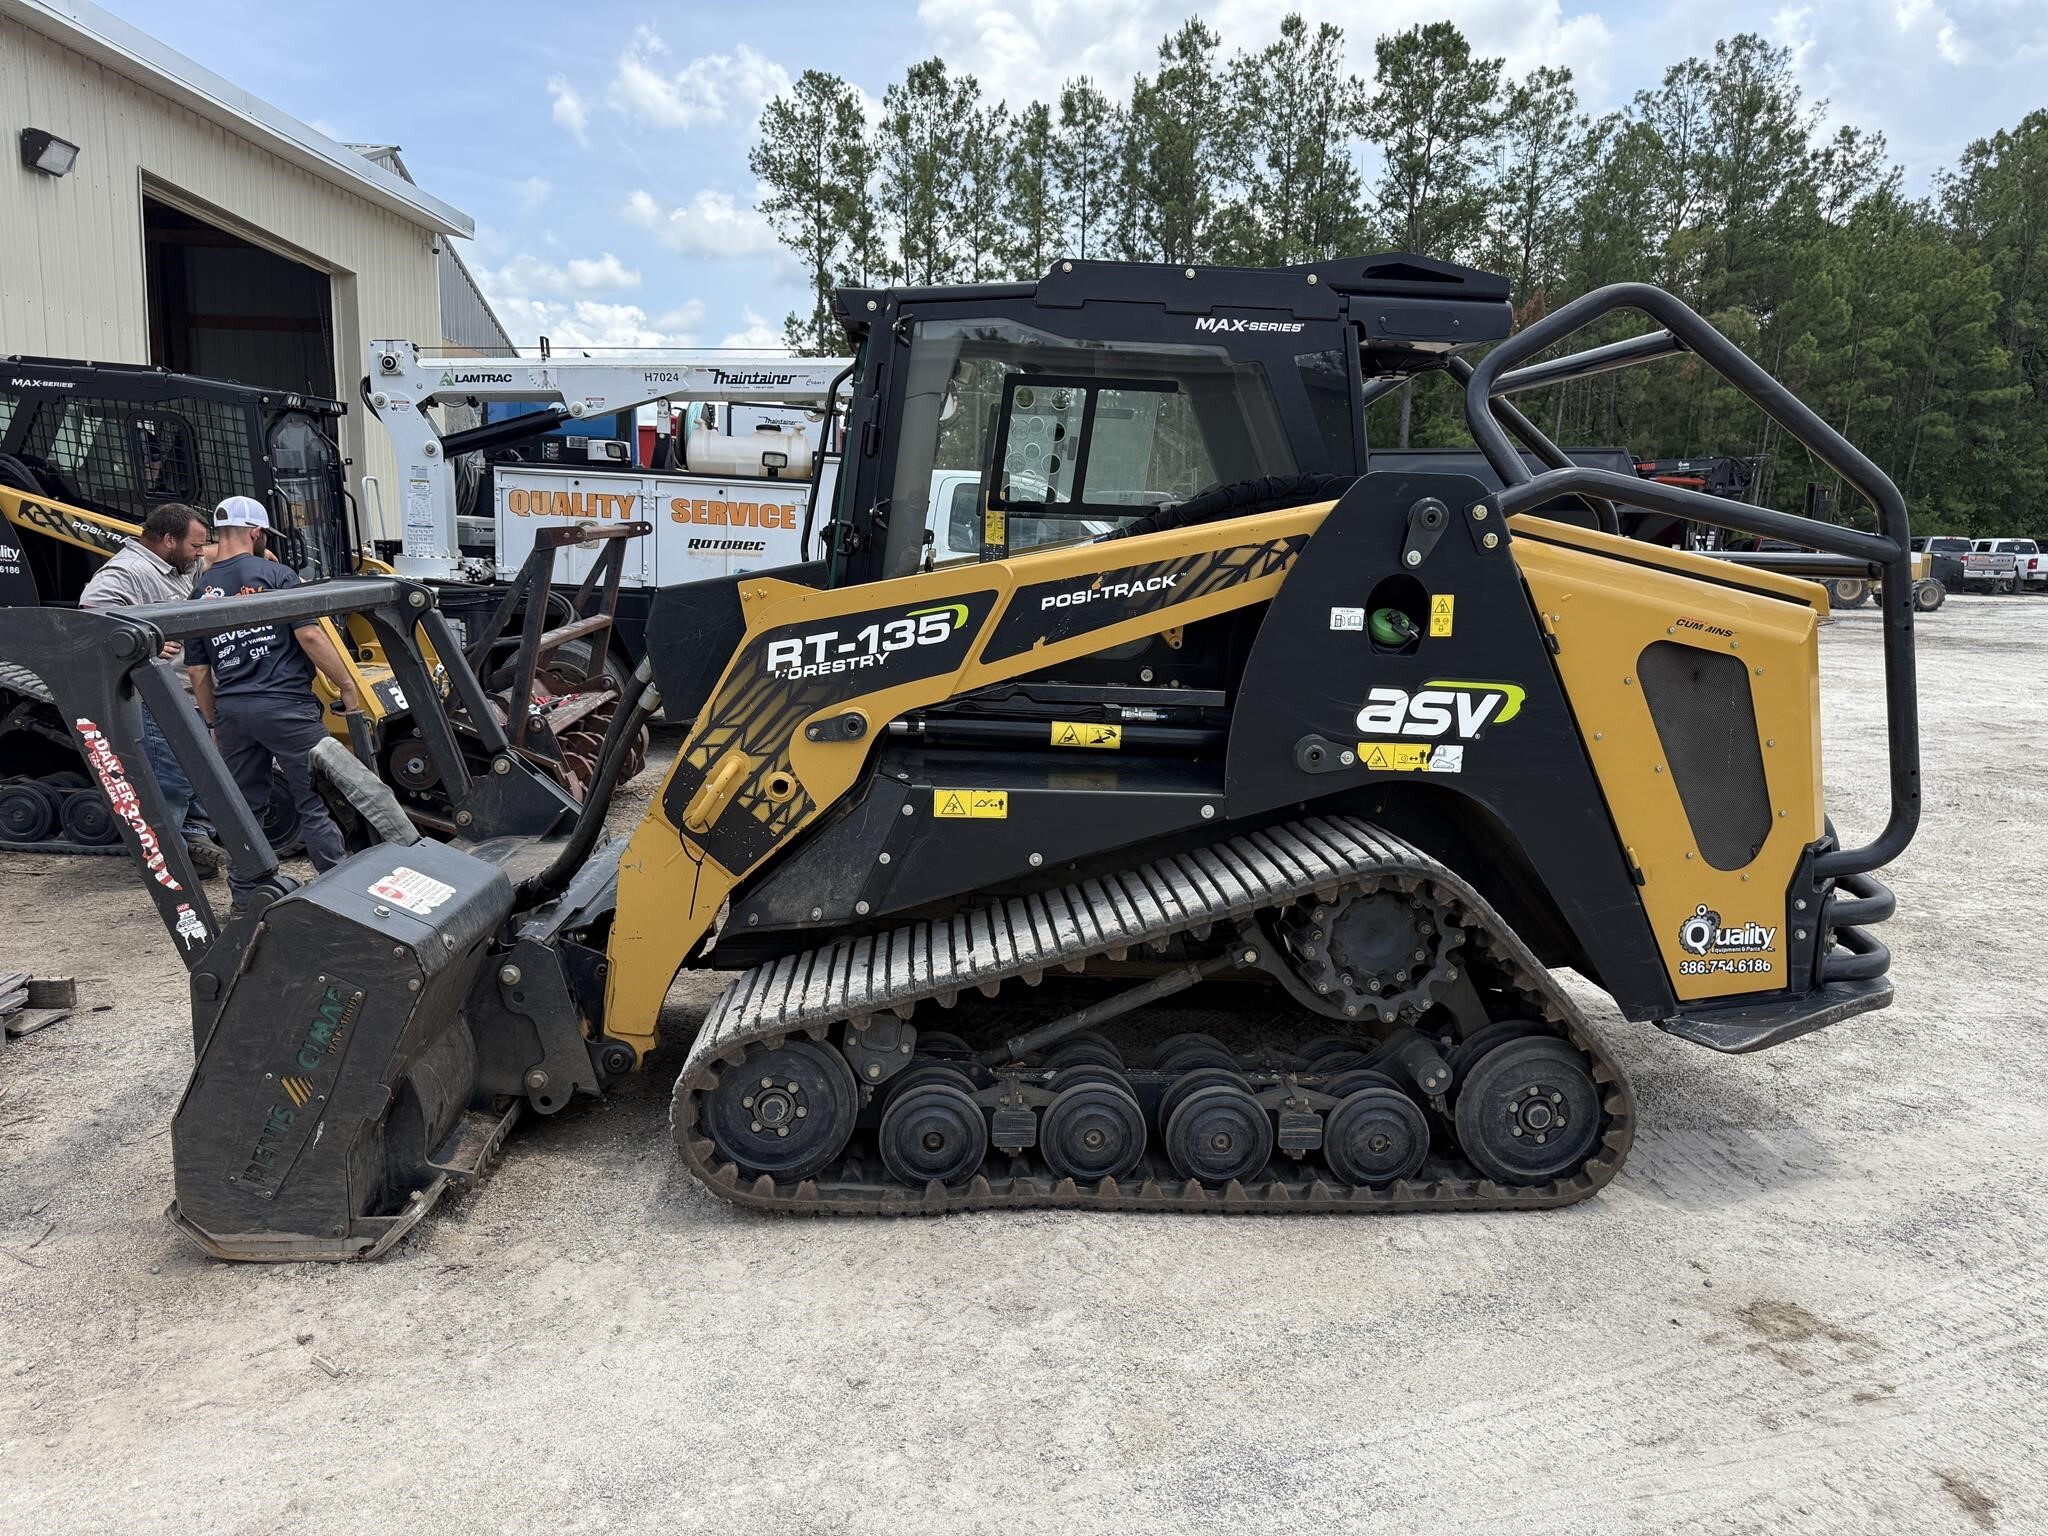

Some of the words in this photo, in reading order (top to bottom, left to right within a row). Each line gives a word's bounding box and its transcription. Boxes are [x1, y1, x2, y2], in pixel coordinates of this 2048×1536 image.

[1195, 317, 1305, 333] MAX-SERIES
[11, 378, 75, 388] MAX-SERIES
[454, 373, 513, 384] LAMTRAC
[645, 372, 680, 383] H7024
[707, 368, 798, 385] Maintainer
[508, 488, 636, 520] QUALITY
[671, 497, 797, 530] SERVICE
[71, 521, 128, 544] POSI-TRA
[1041, 573, 1177, 611] POSI-TRACK
[766, 611, 951, 672] RT-135
[1356, 687, 1502, 738] asv
[101, 775, 119, 804] CLEAR
[1685, 922, 1776, 955] Quality
[1680, 959, 1771, 974] 386.754.6186
